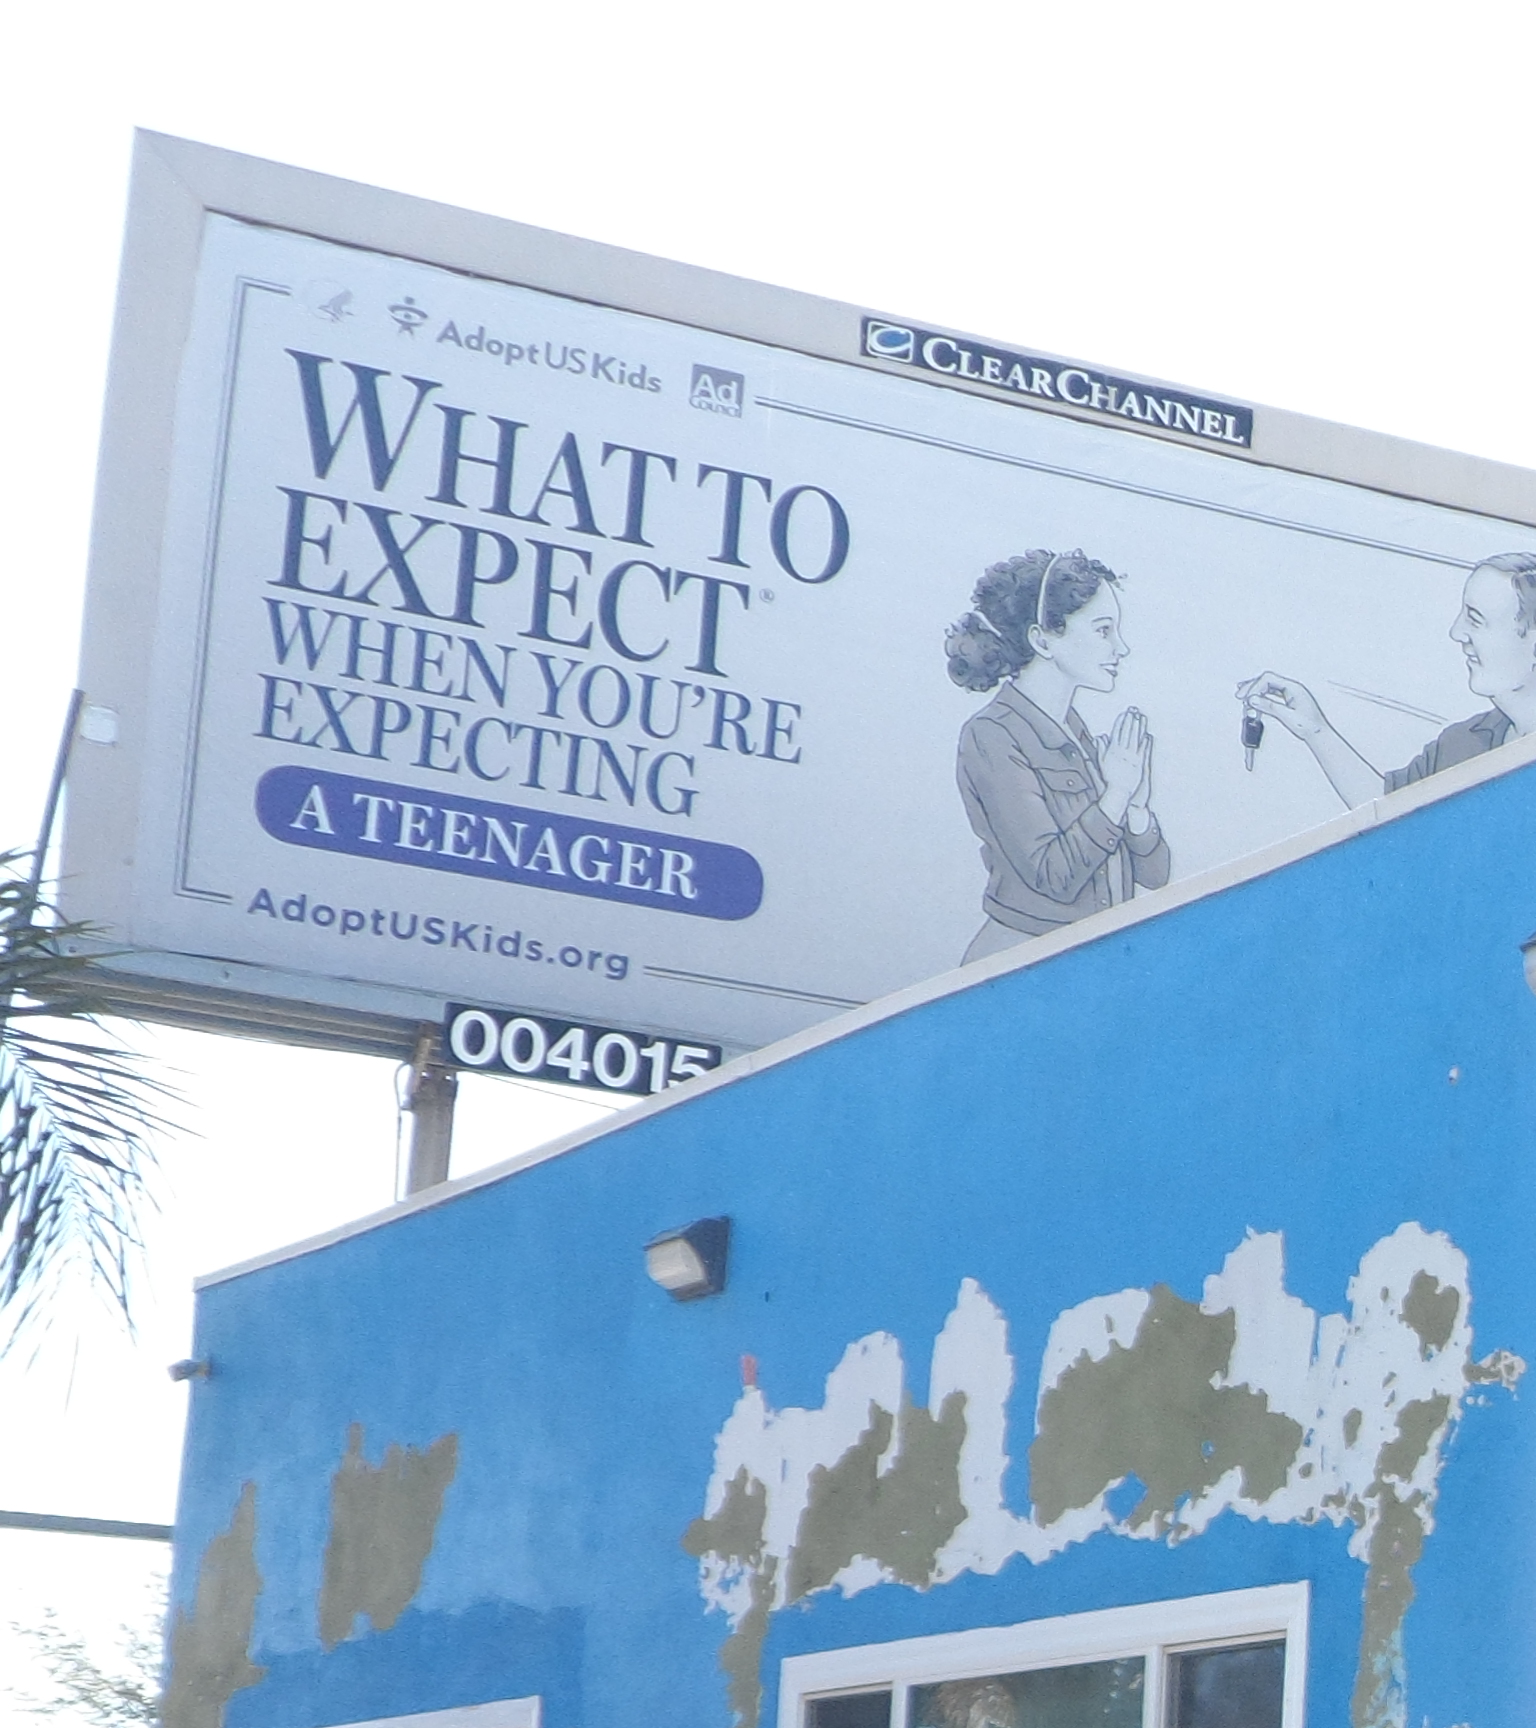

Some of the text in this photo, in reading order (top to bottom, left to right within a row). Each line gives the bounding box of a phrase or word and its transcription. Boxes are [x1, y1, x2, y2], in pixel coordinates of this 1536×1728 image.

[436, 320, 662, 395] AdoptUSKids
[692, 373, 738, 405] Ad
[284, 348, 851, 585] WHAT TO
[260, 597, 802, 765] WHEN YOU'RE
[252, 674, 701, 817] EXPECTING
[289, 785, 698, 899] A TEENAGER
[247, 887, 630, 981] AdoptUSKids.org
[449, 1009, 710, 1094] 004015
